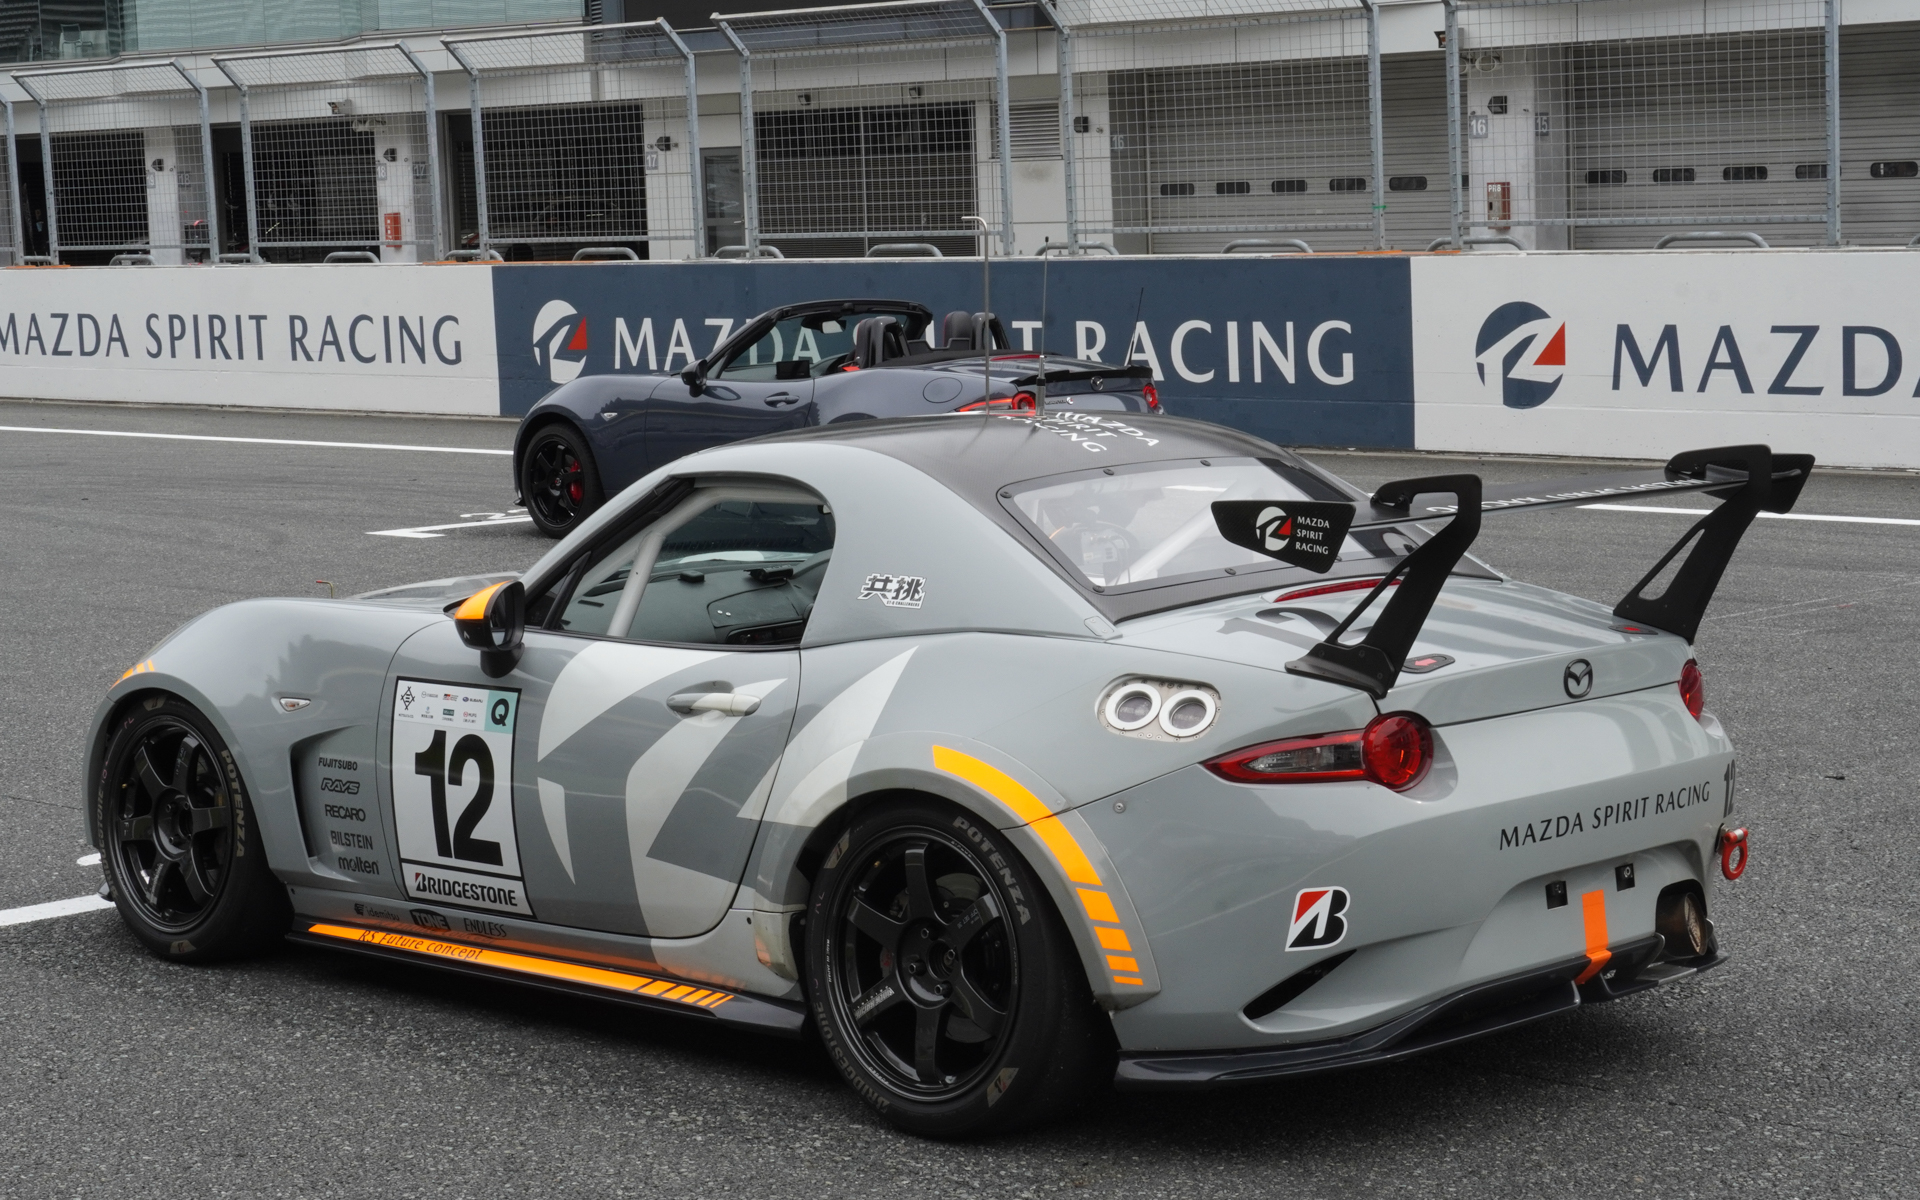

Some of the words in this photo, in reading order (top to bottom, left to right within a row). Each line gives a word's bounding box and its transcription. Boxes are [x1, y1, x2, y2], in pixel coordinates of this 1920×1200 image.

[1470, 119, 1487, 136] 16
[1536, 117, 1548, 133] 15
[1112, 134, 1125, 149] 16
[377, 165, 386, 177] 18
[646, 154, 657, 168] 17
[145, 313, 268, 361] SPIRIT
[289, 314, 462, 366] RACING
[1075, 320, 1354, 386] RACING
[1611, 323, 1920, 398] MAZD
[1055, 411, 1160, 447] MAZDA
[1297, 516, 1330, 528] MAZDA
[1297, 529, 1324, 540] SPIRIT
[1295, 542, 1329, 555] RACING
[861, 575, 923, 602] 共挑
[491, 698, 509, 727] Q
[318, 757, 358, 771] FUJITSUBO
[320, 777, 360, 795] RAYS
[1723, 758, 1736, 819] 12
[221, 750, 246, 858] POTENZA
[414, 729, 504, 867] 12
[324, 804, 366, 822] RECARO
[1500, 813, 1584, 851] MAZDA
[1592, 797, 1650, 830] SPIRIT
[1655, 781, 1710, 815] RACING
[330, 830, 374, 851] BILSTEIN
[338, 856, 380, 875] molten
[952, 815, 1032, 926] POTENZA
[415, 872, 518, 907] BRIDGESTONE
[366, 907, 400, 922] idemitsu
[412, 911, 448, 930] TONE
[464, 918, 507, 938] ENDLESS
[359, 930, 376, 943] RS
[378, 932, 424, 950] Future
[426, 943, 484, 961] concept
[813, 1000, 891, 1114] BRIDGESTONE
